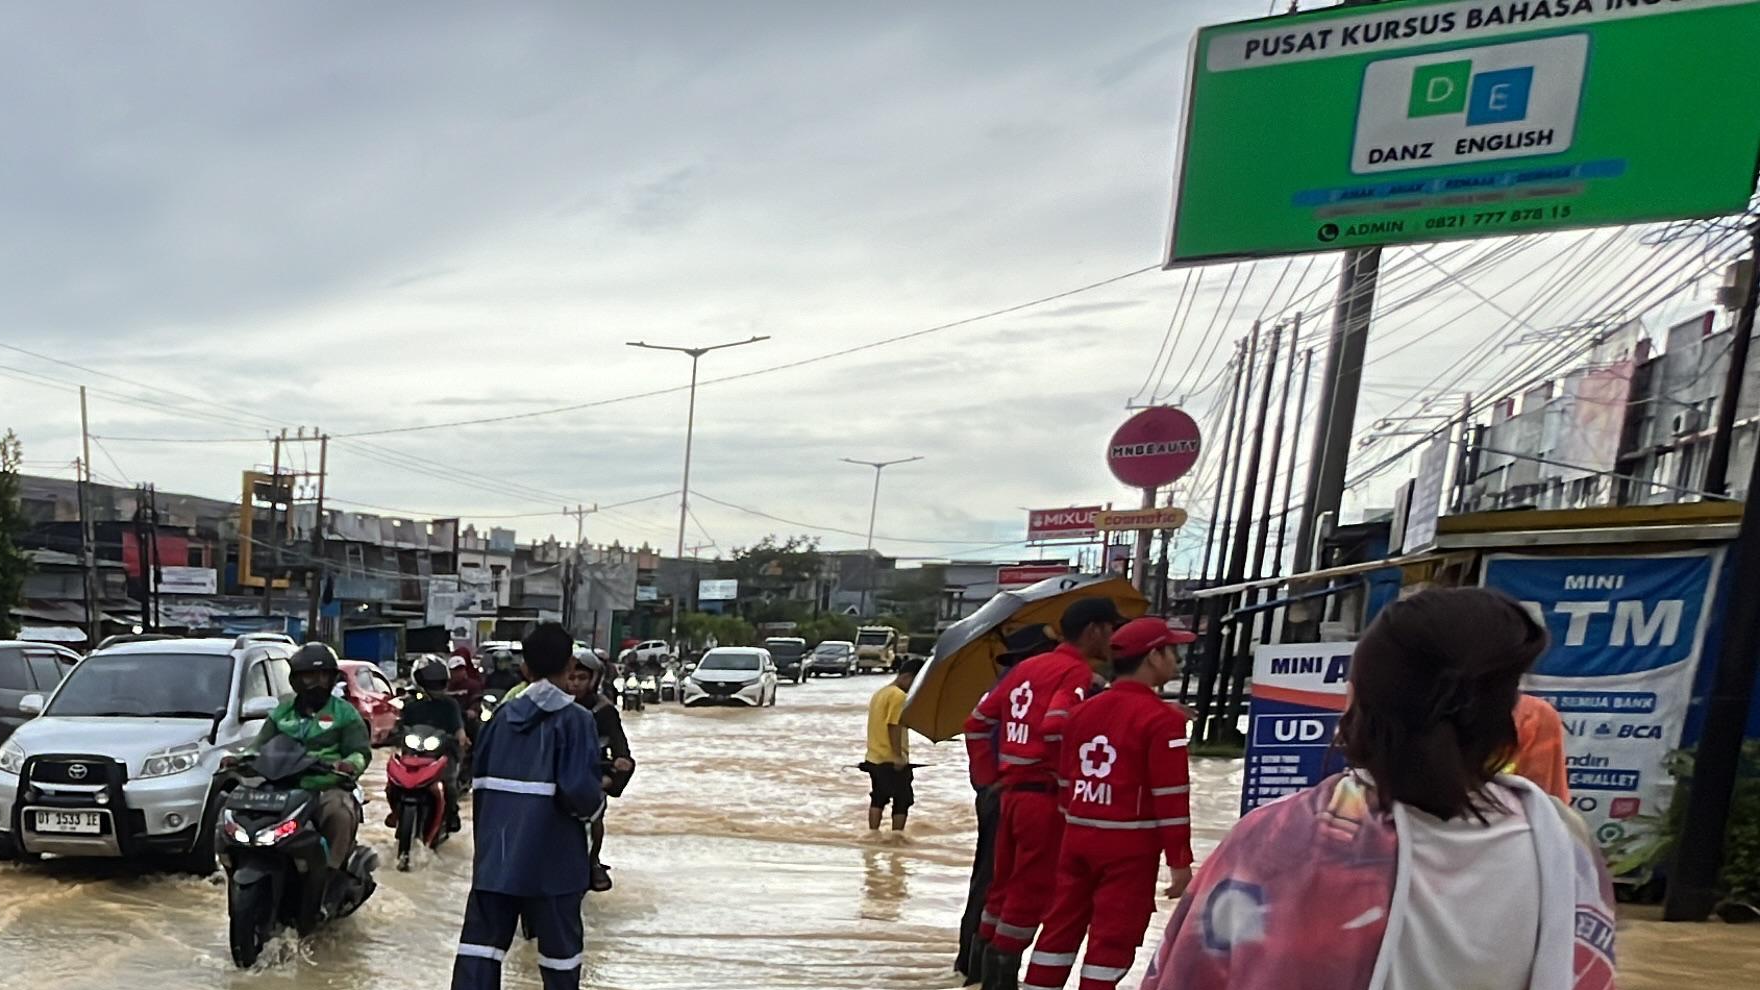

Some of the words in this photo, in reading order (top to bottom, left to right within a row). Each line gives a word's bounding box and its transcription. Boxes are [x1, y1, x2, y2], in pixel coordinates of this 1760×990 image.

[1244, 29, 1332, 60] PUSAT
[1341, 12, 1456, 47] KURSUS
[1466, 0, 1593, 29] BAHASA
[1426, 77, 1454, 102] D
[1489, 83, 1511, 111] E
[1368, 142, 1434, 165] DANZ
[1455, 129, 1554, 155] ENGLISH
[1345, 219, 1405, 236] ADMIN
[1473, 210, 1507, 225] 777
[1551, 205, 1571, 220] 15
[1044, 511, 1099, 527] MIXUE
[1564, 575, 1625, 590] MINI
[1519, 600, 1684, 646] TM
[1271, 656, 1323, 675] MINI
[1613, 697, 1653, 708] BANK
[1274, 719, 1325, 742] UD
[1562, 720, 1586, 736] NI
[1617, 724, 1662, 739] BCA
[1072, 779, 1113, 805] PMI
